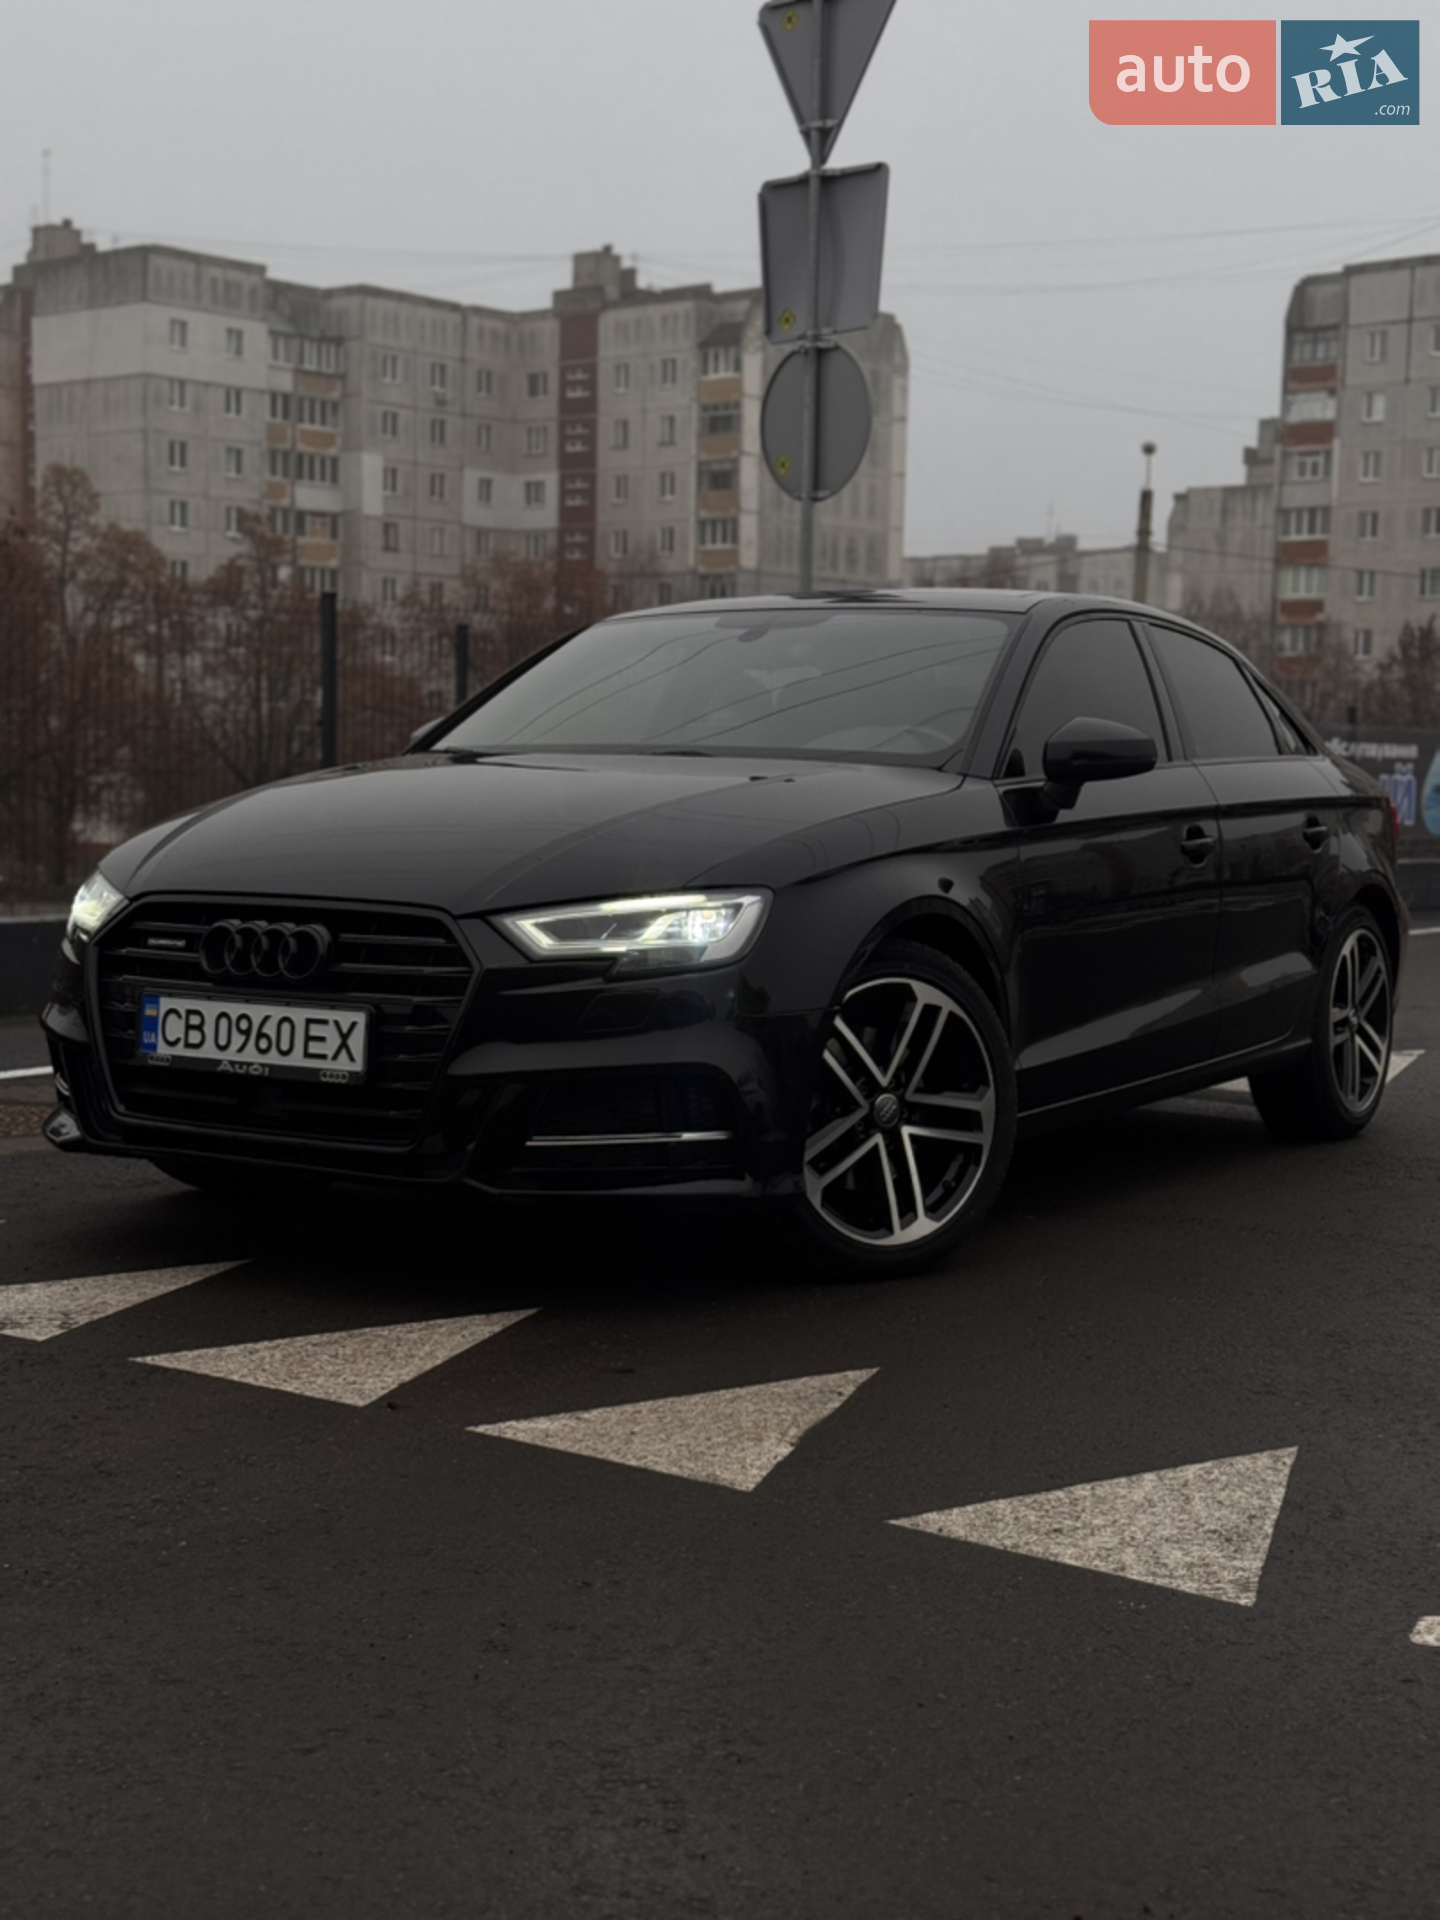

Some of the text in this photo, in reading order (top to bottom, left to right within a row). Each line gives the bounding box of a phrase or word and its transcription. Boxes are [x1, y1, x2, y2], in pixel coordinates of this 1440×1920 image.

[161, 1007, 359, 1063] CB 0960 EX
[216, 1060, 270, 1076] Audi
